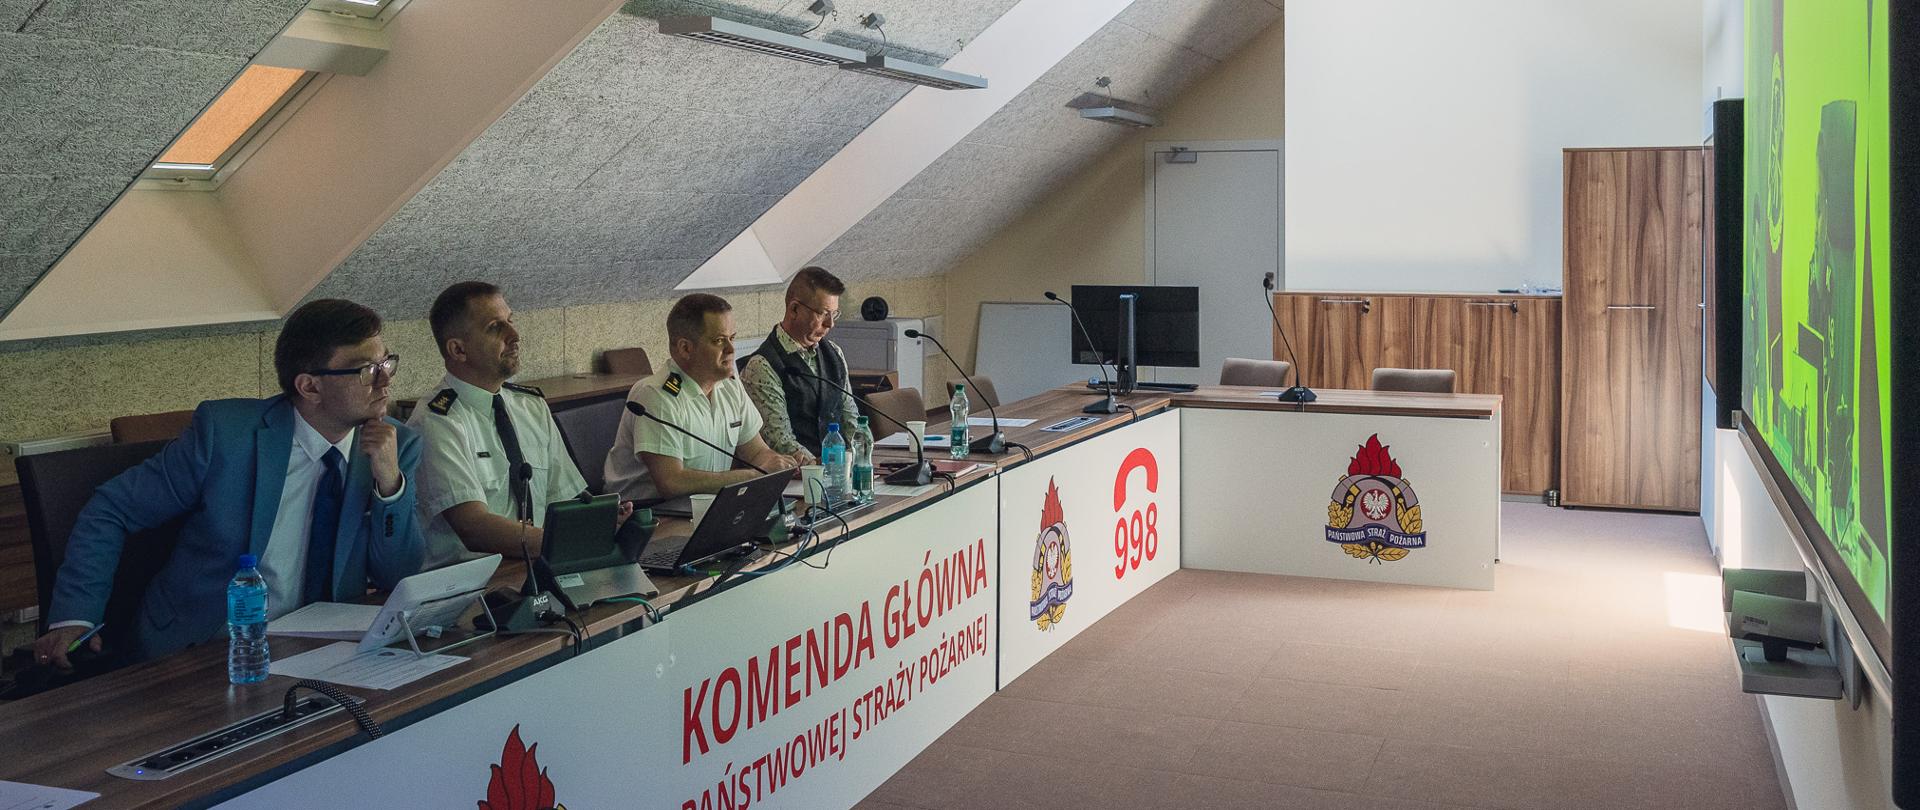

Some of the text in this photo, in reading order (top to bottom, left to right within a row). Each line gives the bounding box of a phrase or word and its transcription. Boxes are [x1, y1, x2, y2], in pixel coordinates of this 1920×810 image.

[1114, 502, 1158, 580] 998
[1327, 527, 1423, 546] PAŃSTWOWA STRAŻ POŻARNA
[533, 595, 549, 606] AKG
[682, 537, 988, 766] KOMENDA GŁÓWNA
[681, 613, 988, 810] ŃSTWOWEJ STRAŻY POŻARNEJ
